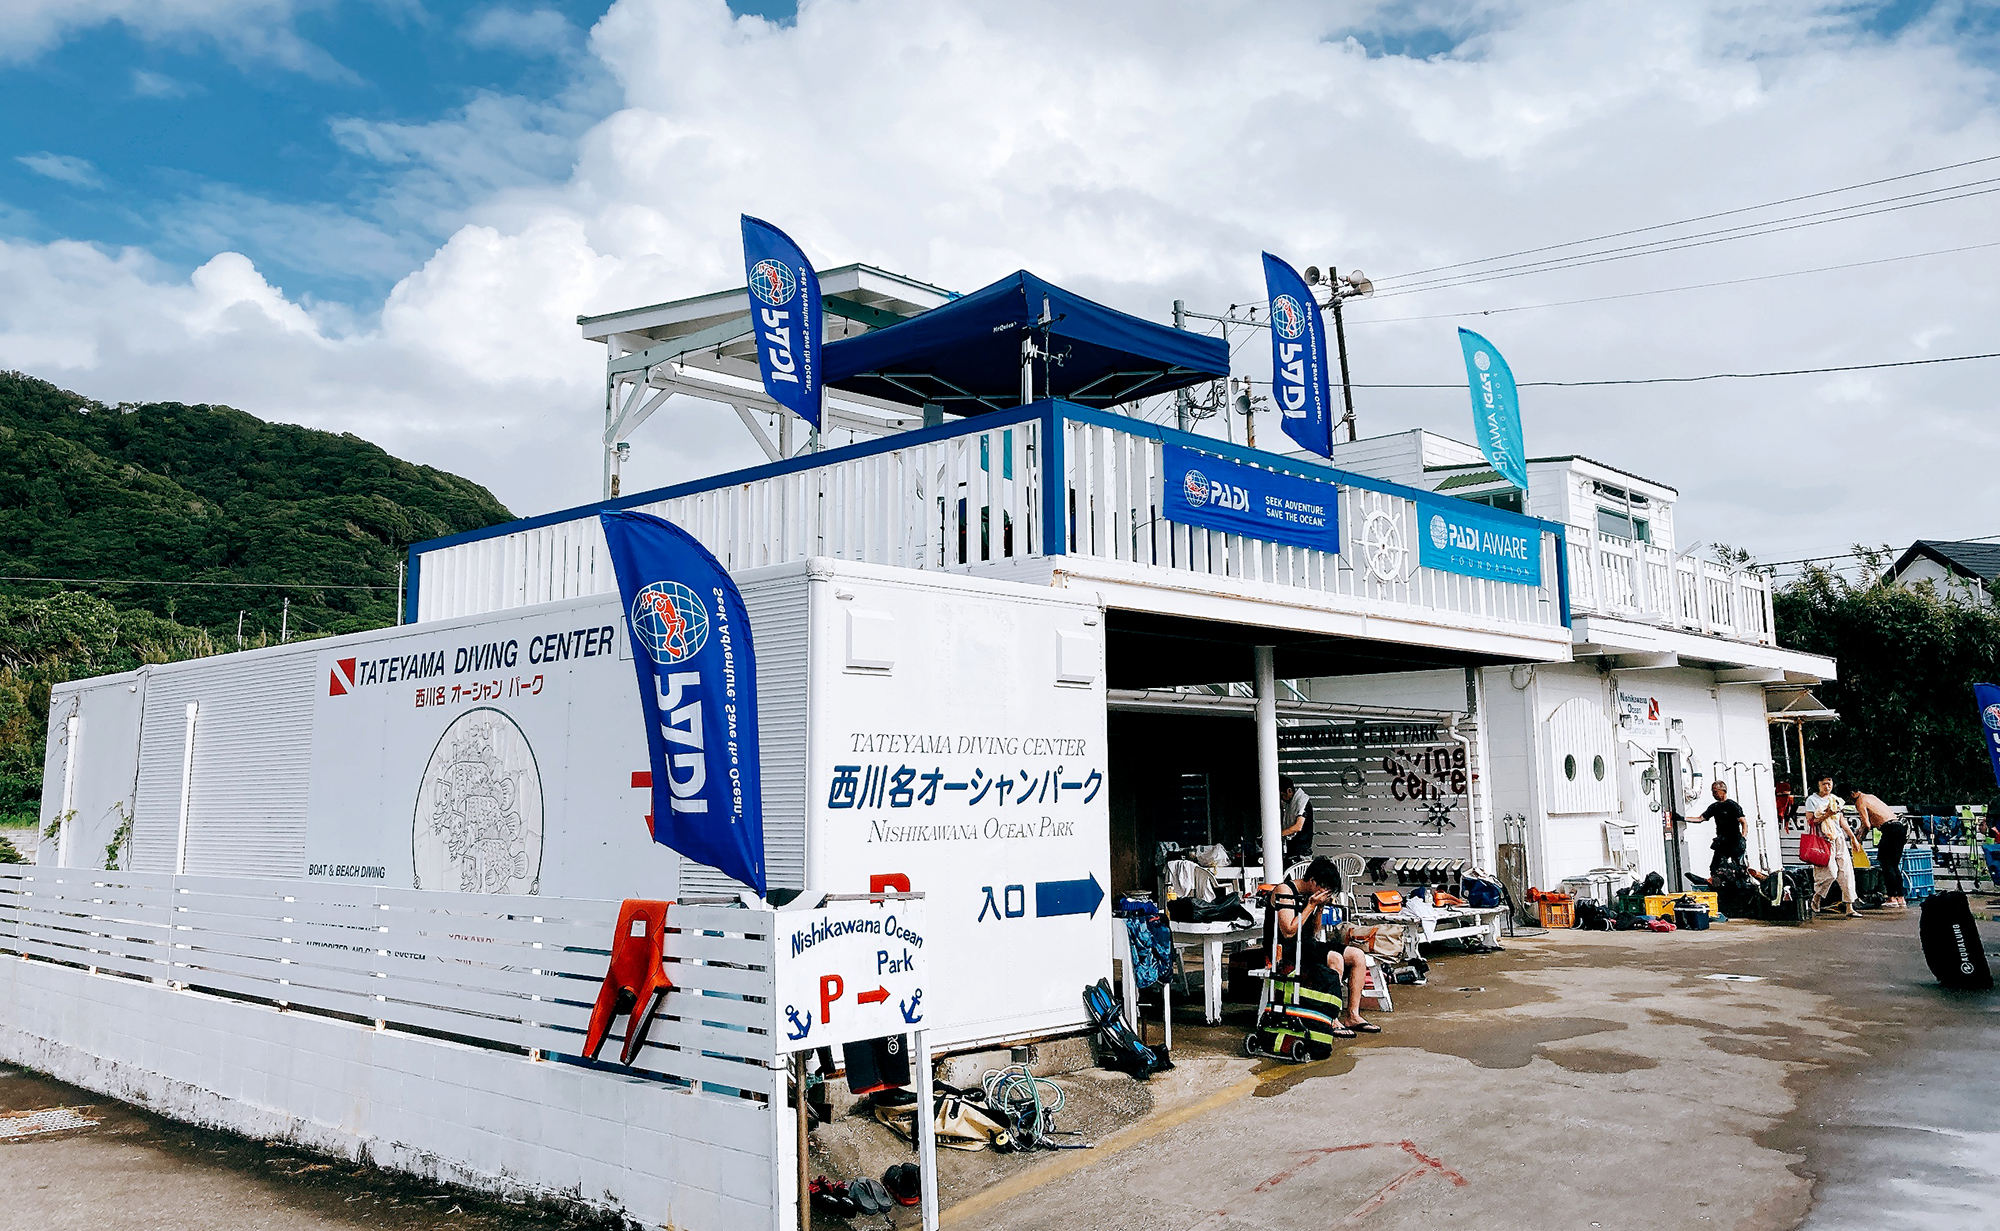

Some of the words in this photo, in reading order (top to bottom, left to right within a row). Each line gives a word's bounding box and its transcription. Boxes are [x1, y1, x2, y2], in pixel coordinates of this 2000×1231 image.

[1210, 480, 1249, 512] PADI
[1265, 496, 1282, 508] SEEK
[1284, 500, 1326, 516] ADVENTURE.
[1266, 508, 1284, 520] SAVE
[1285, 512, 1298, 522] THE
[1448, 524, 1480, 552] PADI
[1482, 532, 1528, 560] AWARE
[1450, 554, 1530, 576] FOUNDATION
[360, 650, 445, 686] TATEYAMA
[454, 639, 519, 675] DIVING
[528, 625, 615, 664] CENTER
[415, 684, 446, 708] 西川名
[850, 732, 952, 754] TATEYAMA
[958, 735, 1018, 756] DIVING
[1022, 737, 1086, 756] CENTER
[1351, 725, 1397, 744] OCEAN
[1402, 724, 1440, 742] PARK
[828, 764, 1104, 810] 西川名オーシャンパーク
[867, 819, 978, 843] NISHIKAWANA
[984, 817, 1036, 840] OCEAN
[1038, 816, 1074, 838] PARK
[308, 863, 328, 877] BOAT
[328, 865, 334, 877] &
[335, 865, 360, 878] BEACH
[361, 866, 386, 880] DIVING
[978, 884, 1025, 922] 入口
[792, 916, 881, 959] Nishikawana
[884, 915, 924, 949] Ocean
[1952, 924, 1970, 962] AQUALUNG
[877, 948, 914, 976] Park
[820, 974, 844, 1024] P
